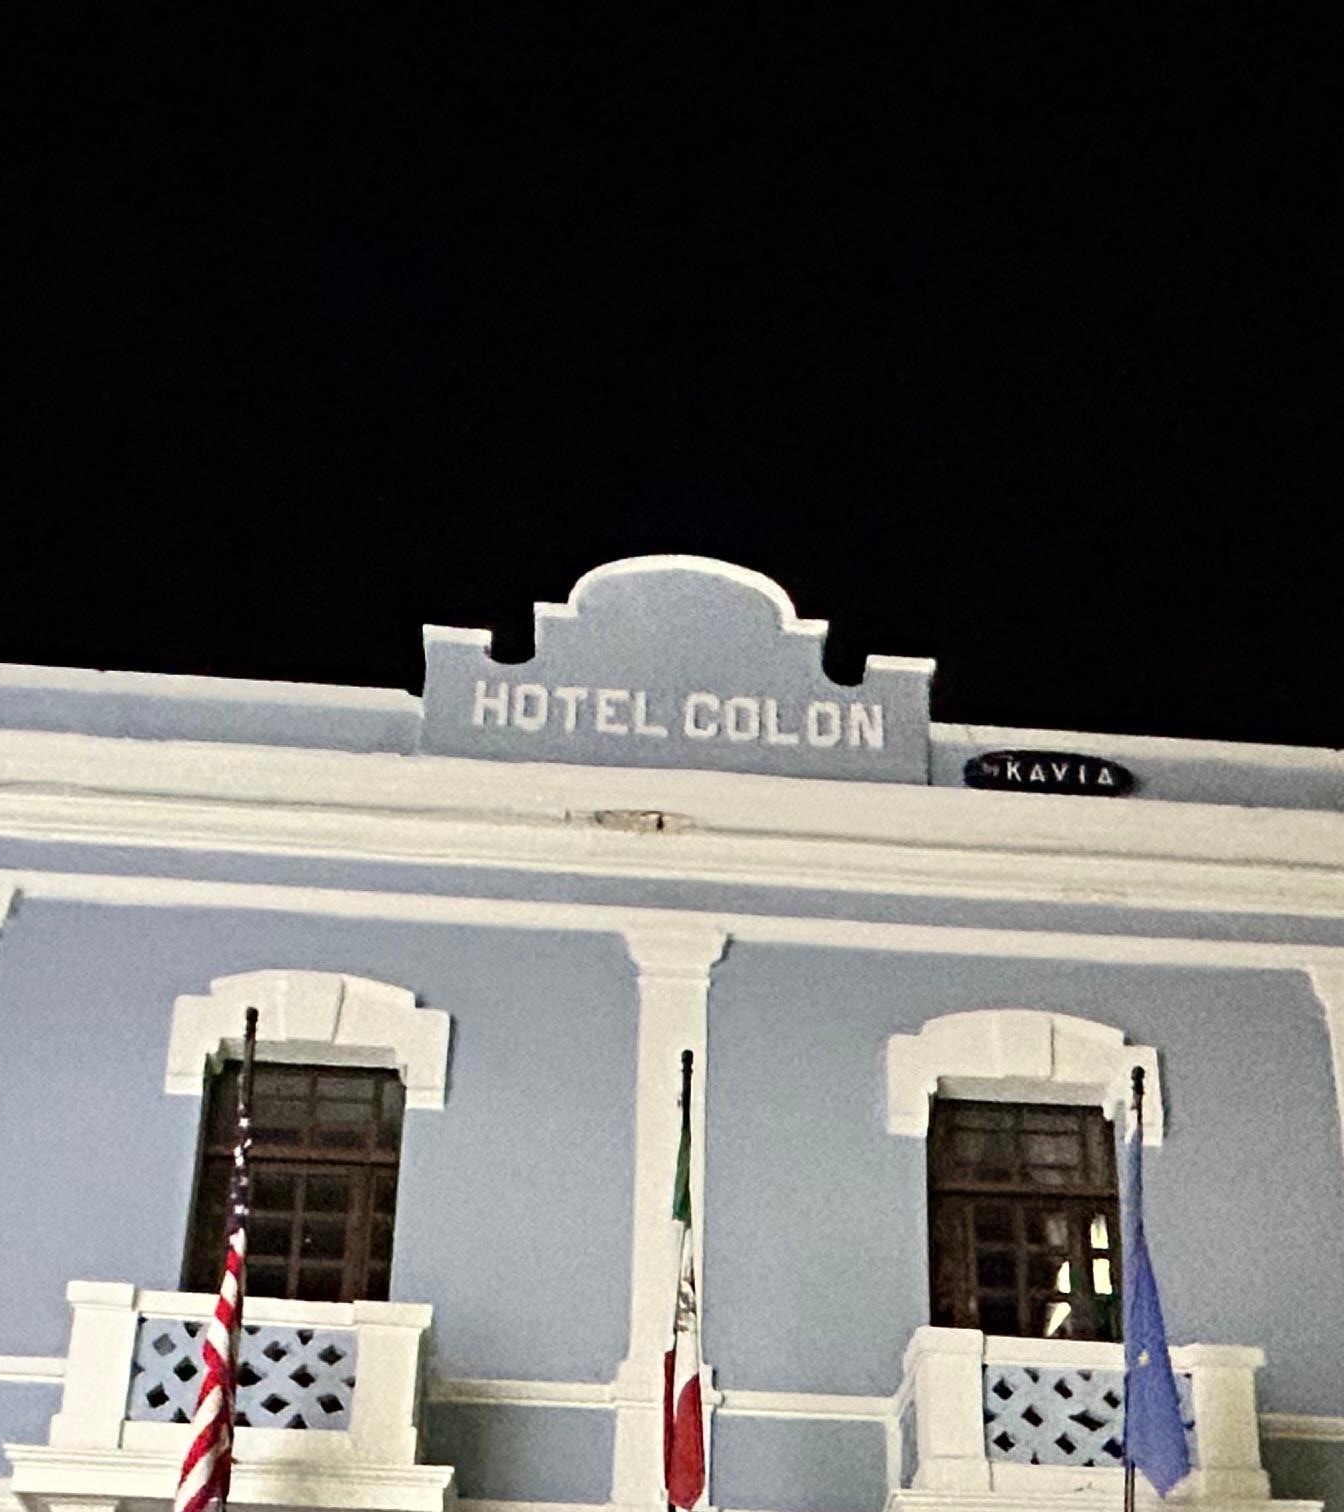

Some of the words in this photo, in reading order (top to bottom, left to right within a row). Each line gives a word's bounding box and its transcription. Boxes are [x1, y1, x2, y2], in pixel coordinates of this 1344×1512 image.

[471, 679, 669, 738] HOTEL
[682, 691, 885, 749] COLON
[1006, 760, 1114, 786] KAVIA
